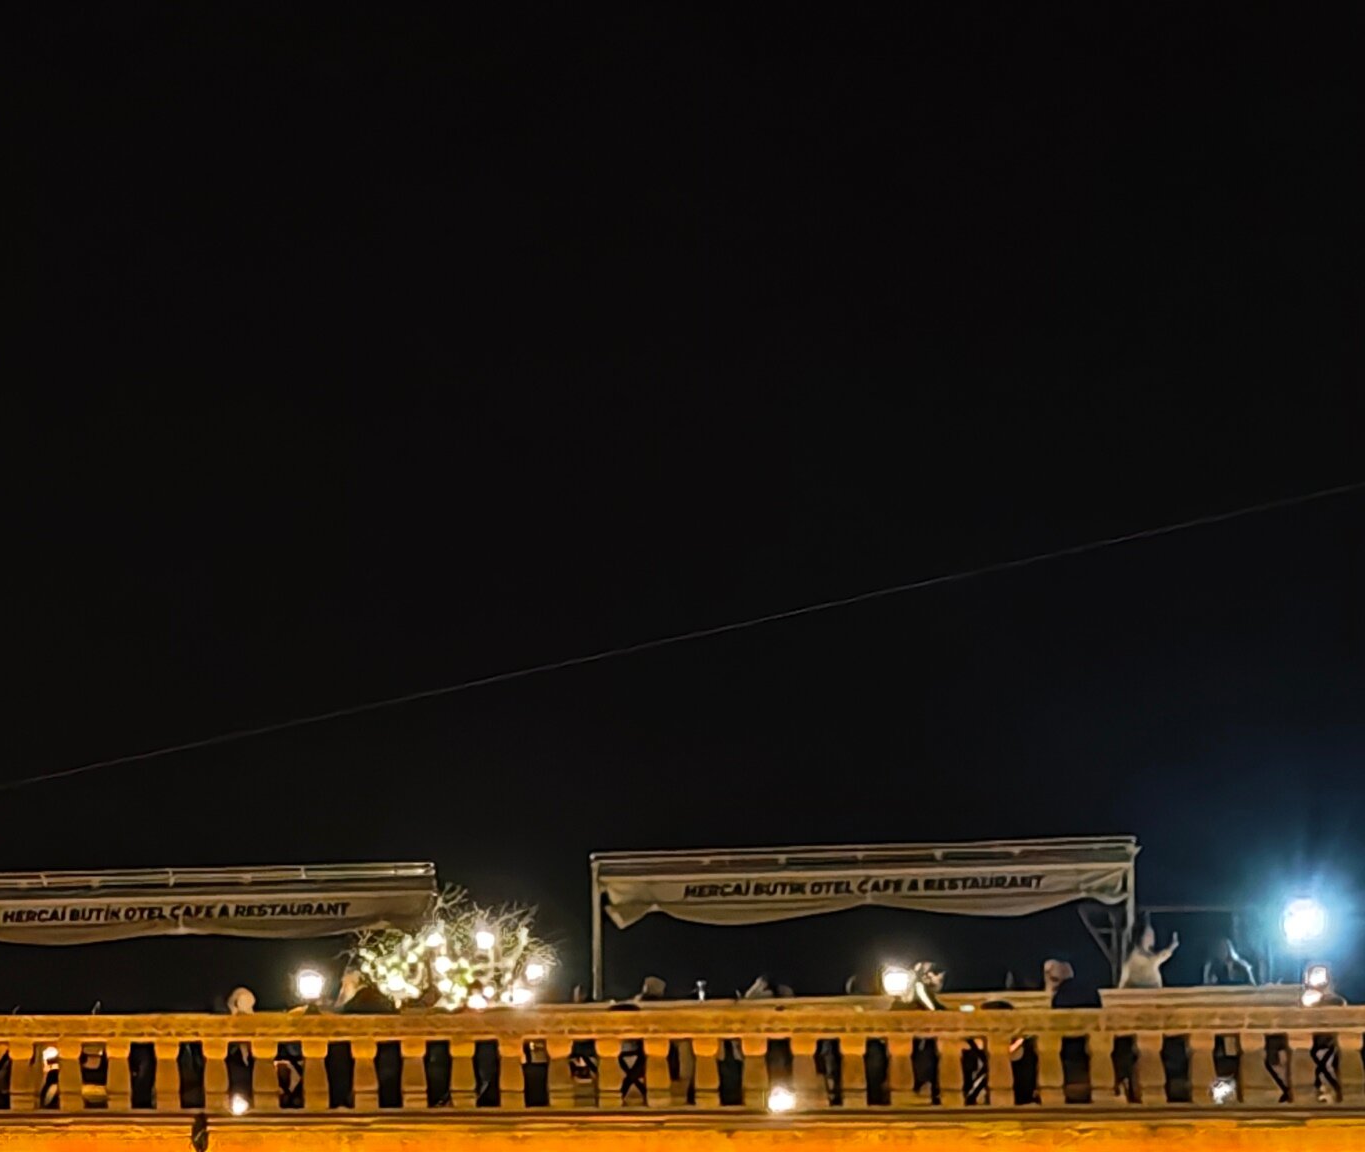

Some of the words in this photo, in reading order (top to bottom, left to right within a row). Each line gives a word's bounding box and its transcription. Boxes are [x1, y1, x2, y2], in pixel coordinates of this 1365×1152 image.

[809, 880, 854, 895] OTEL
[856, 877, 904, 894] CAFE
[923, 874, 1046, 892] RESTAURANT
[124, 905, 168, 921] OTEL
[169, 904, 216, 921] CAFE
[233, 902, 351, 918] RESTAURANT
